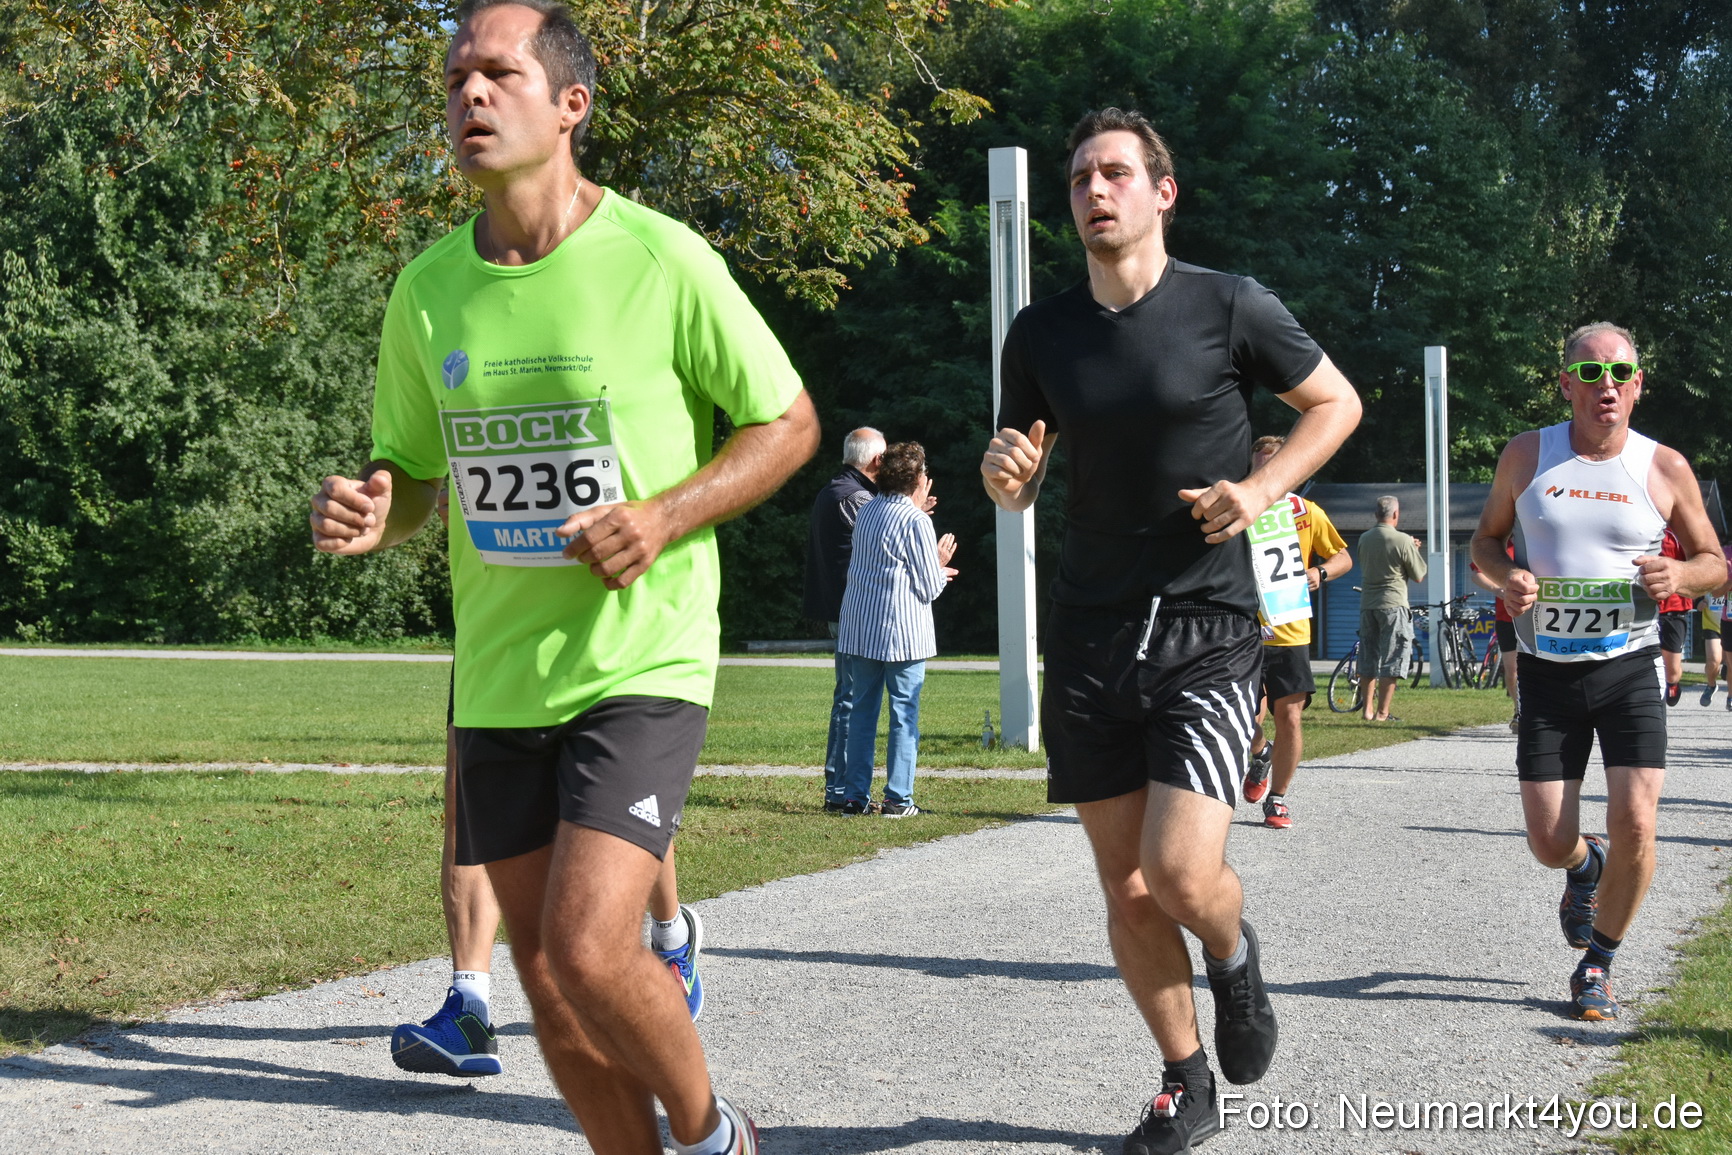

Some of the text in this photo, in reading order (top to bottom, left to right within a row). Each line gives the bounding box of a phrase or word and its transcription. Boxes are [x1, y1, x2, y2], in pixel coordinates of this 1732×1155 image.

[484, 354, 594, 368] Freie katholische Volksschule
[510, 367, 519, 375] St.
[452, 408, 598, 451] BOCK
[602, 460, 610, 468] D
[467, 459, 601, 511] 2236
[1569, 489, 1633, 504] KLEBL
[1542, 581, 1625, 600] BOCK
[1545, 607, 1620, 633] 2721
